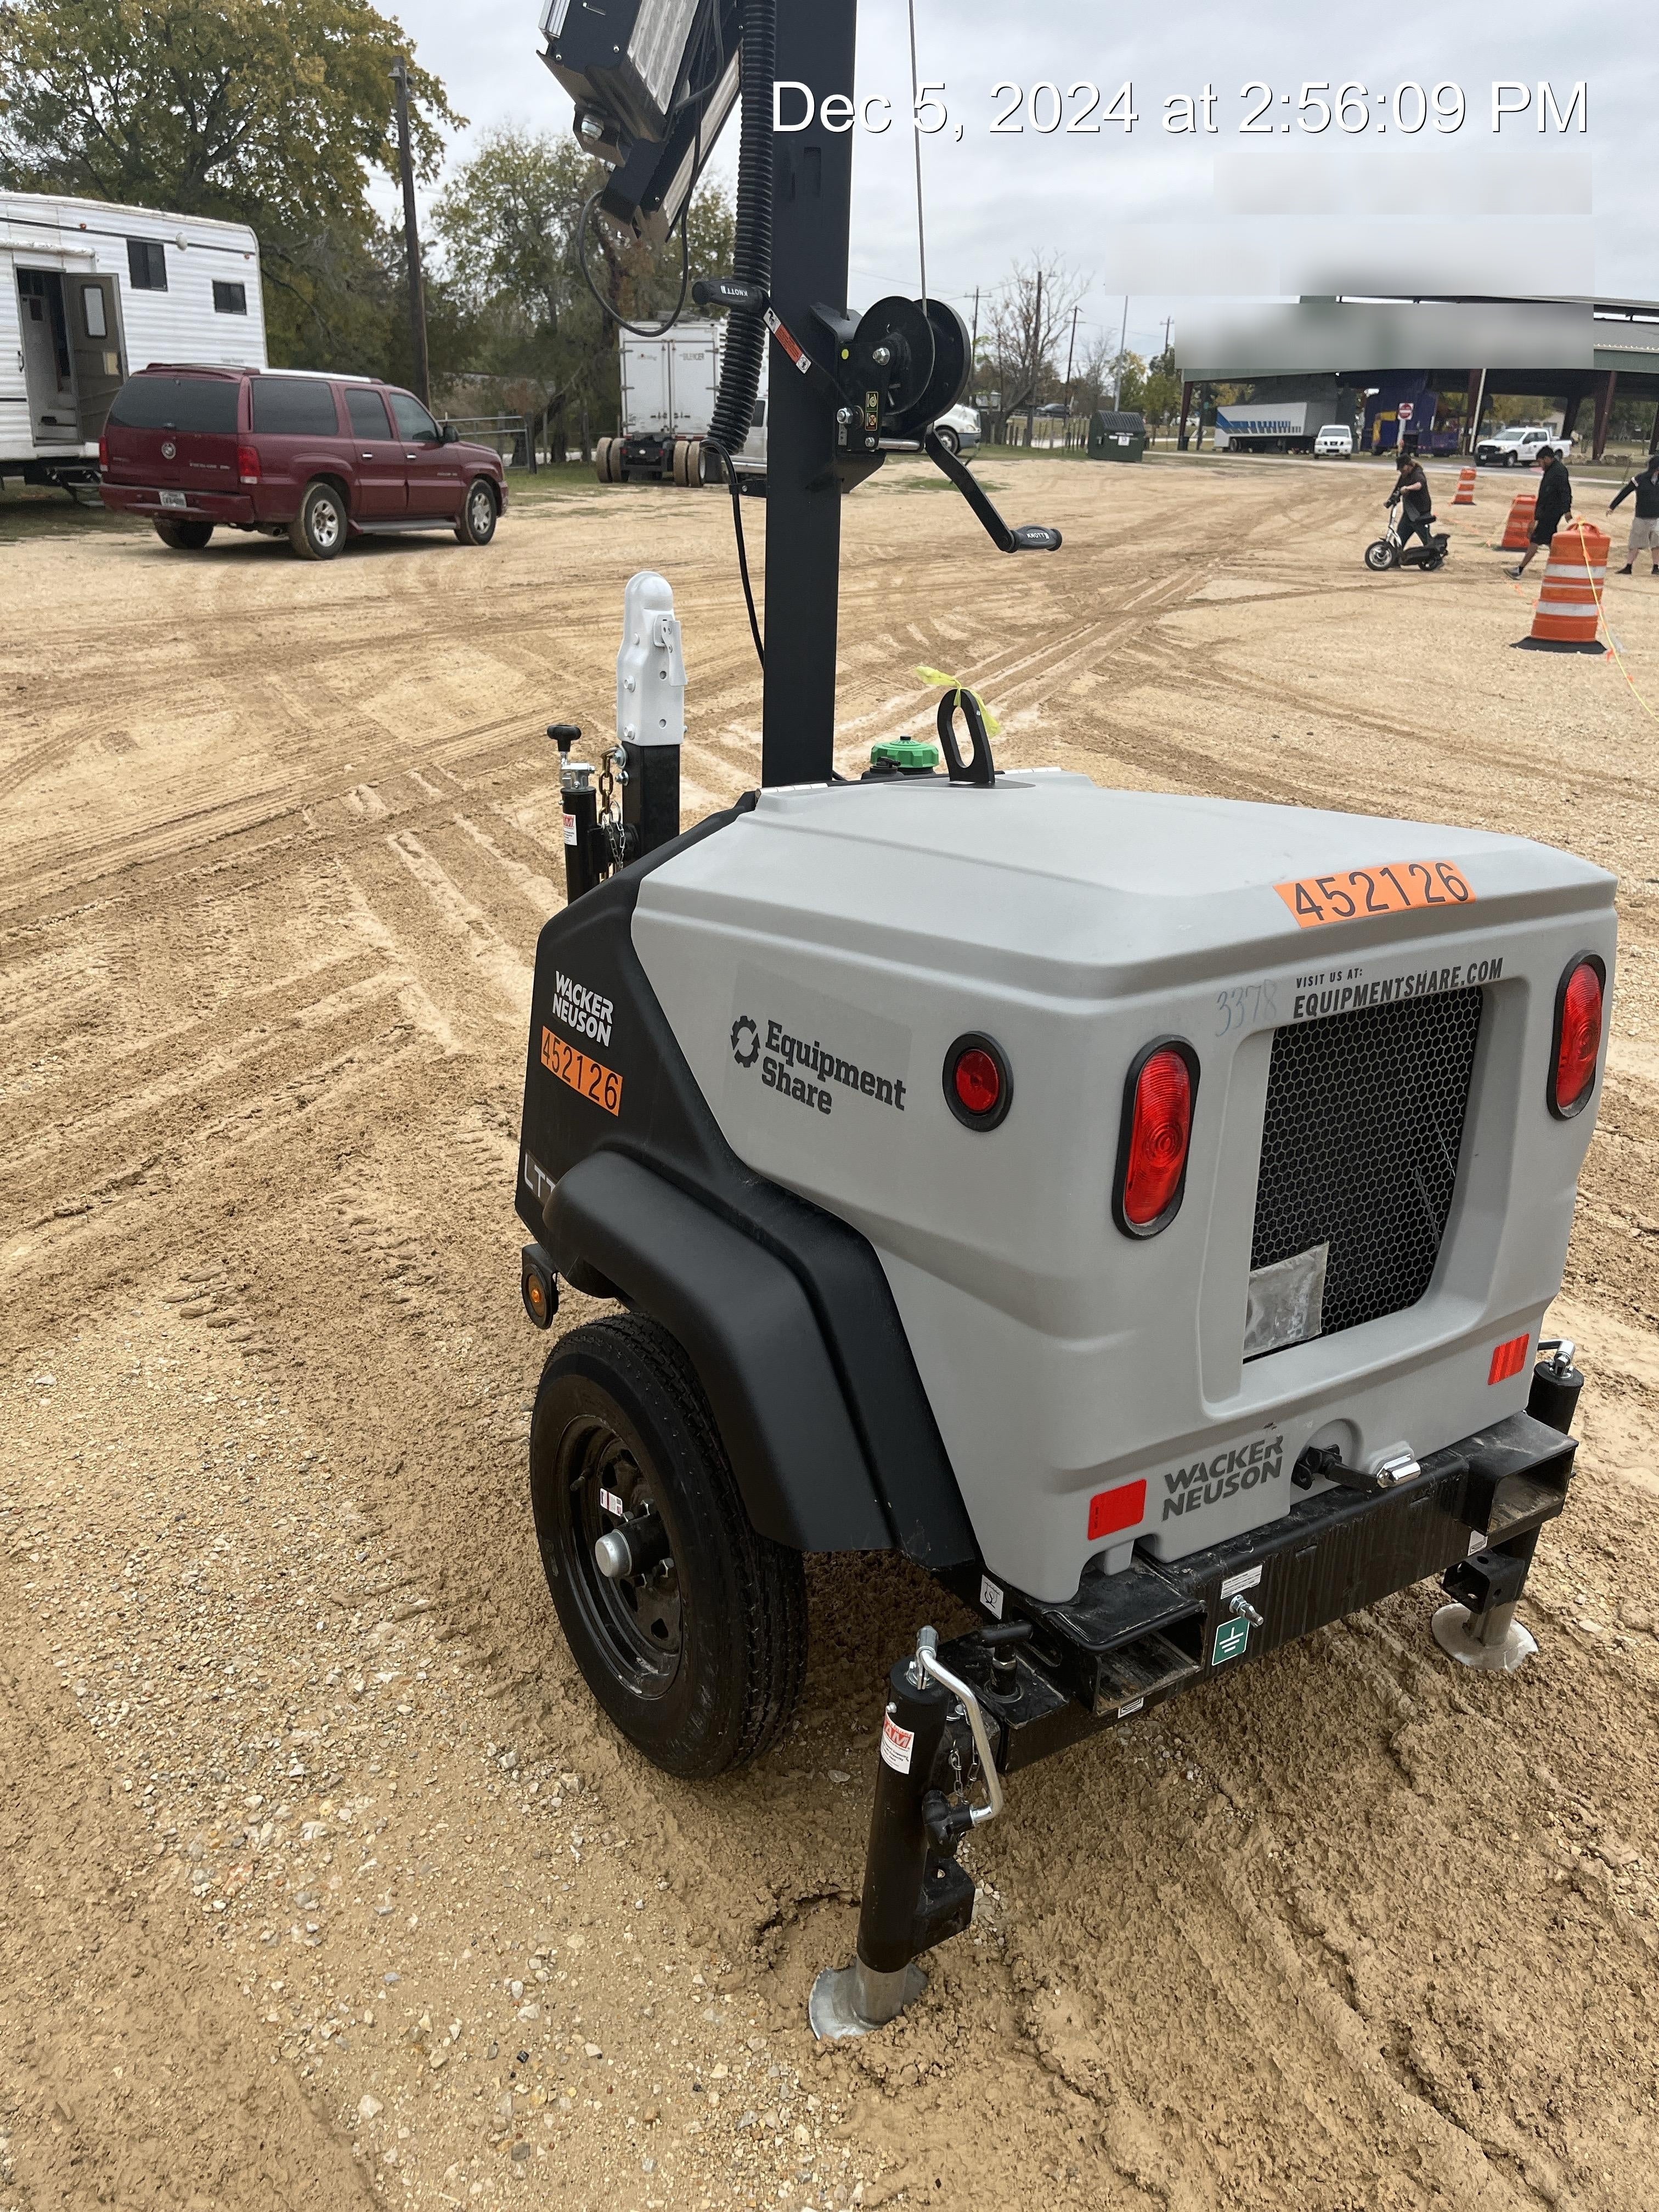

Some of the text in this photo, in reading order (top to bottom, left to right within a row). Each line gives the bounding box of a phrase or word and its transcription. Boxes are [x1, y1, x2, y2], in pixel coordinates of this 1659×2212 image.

[727, 287, 748, 297] KNOTT
[1295, 862, 1469, 921] 452126
[555, 970, 614, 1025] WACKER
[1293, 957, 1503, 1019] EQUIPMENTSHARE.COM
[1296, 968, 1363, 989] VISIT US AT:
[552, 993, 612, 1047] NEUSON
[543, 1032, 619, 1110] 452126
[761, 1056, 832, 1115] Share
[765, 1019, 906, 1111] Equipment
[1161, 1455, 1283, 1521] NEUSON
[1164, 1435, 1284, 1494] WACKER
